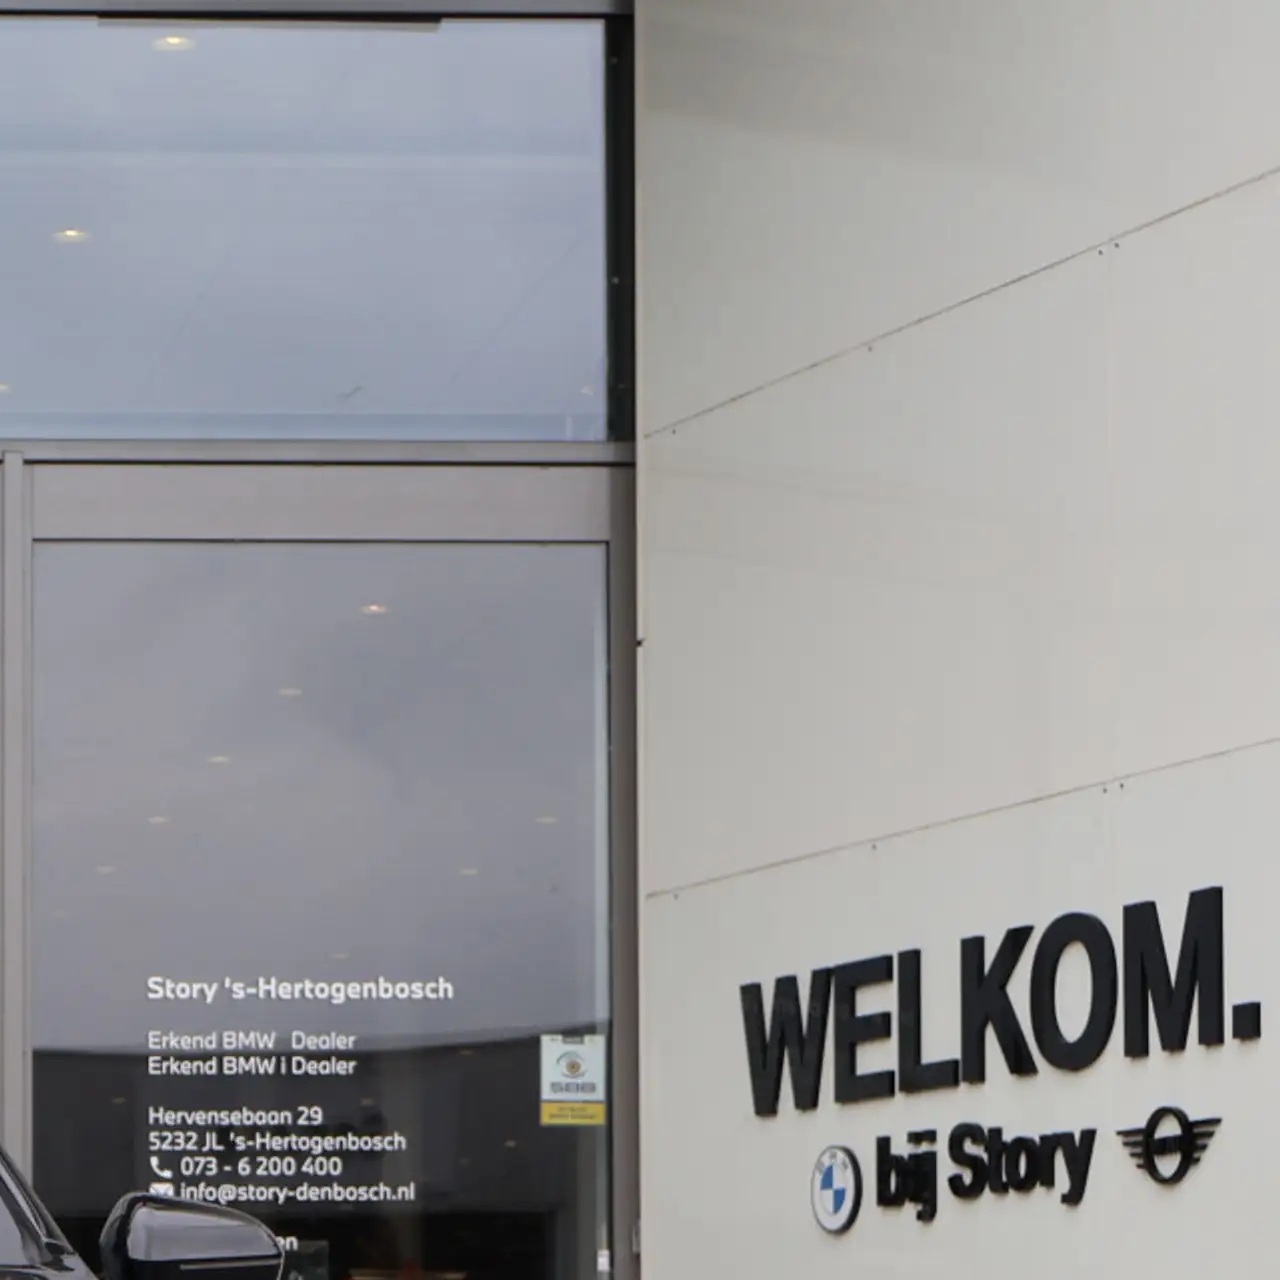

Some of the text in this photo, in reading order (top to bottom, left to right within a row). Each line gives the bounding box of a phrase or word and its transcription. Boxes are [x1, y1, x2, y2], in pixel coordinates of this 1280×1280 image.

[147, 976, 218, 1003] Story
[740, 886, 1261, 1117] WELKOM.
[147, 1031, 357, 1050] Erkend BMW Dealer
[147, 1056, 217, 1076] Erkend
[222, 1056, 276, 1076] BMW
[291, 1056, 357, 1076] Dealer
[148, 1106, 323, 1126] Hervensebaan 29
[148, 1132, 198, 1151] 5232
[203, 1132, 224, 1151] JL
[180, 1156, 218, 1176] 073
[237, 1156, 251, 1176] 6
[256, 1156, 295, 1176] 200
[301, 1156, 342, 1176] 400
[876, 1123, 1097, 1223] bij Story
[180, 1181, 416, 1204] info@story-denbosch.nl
